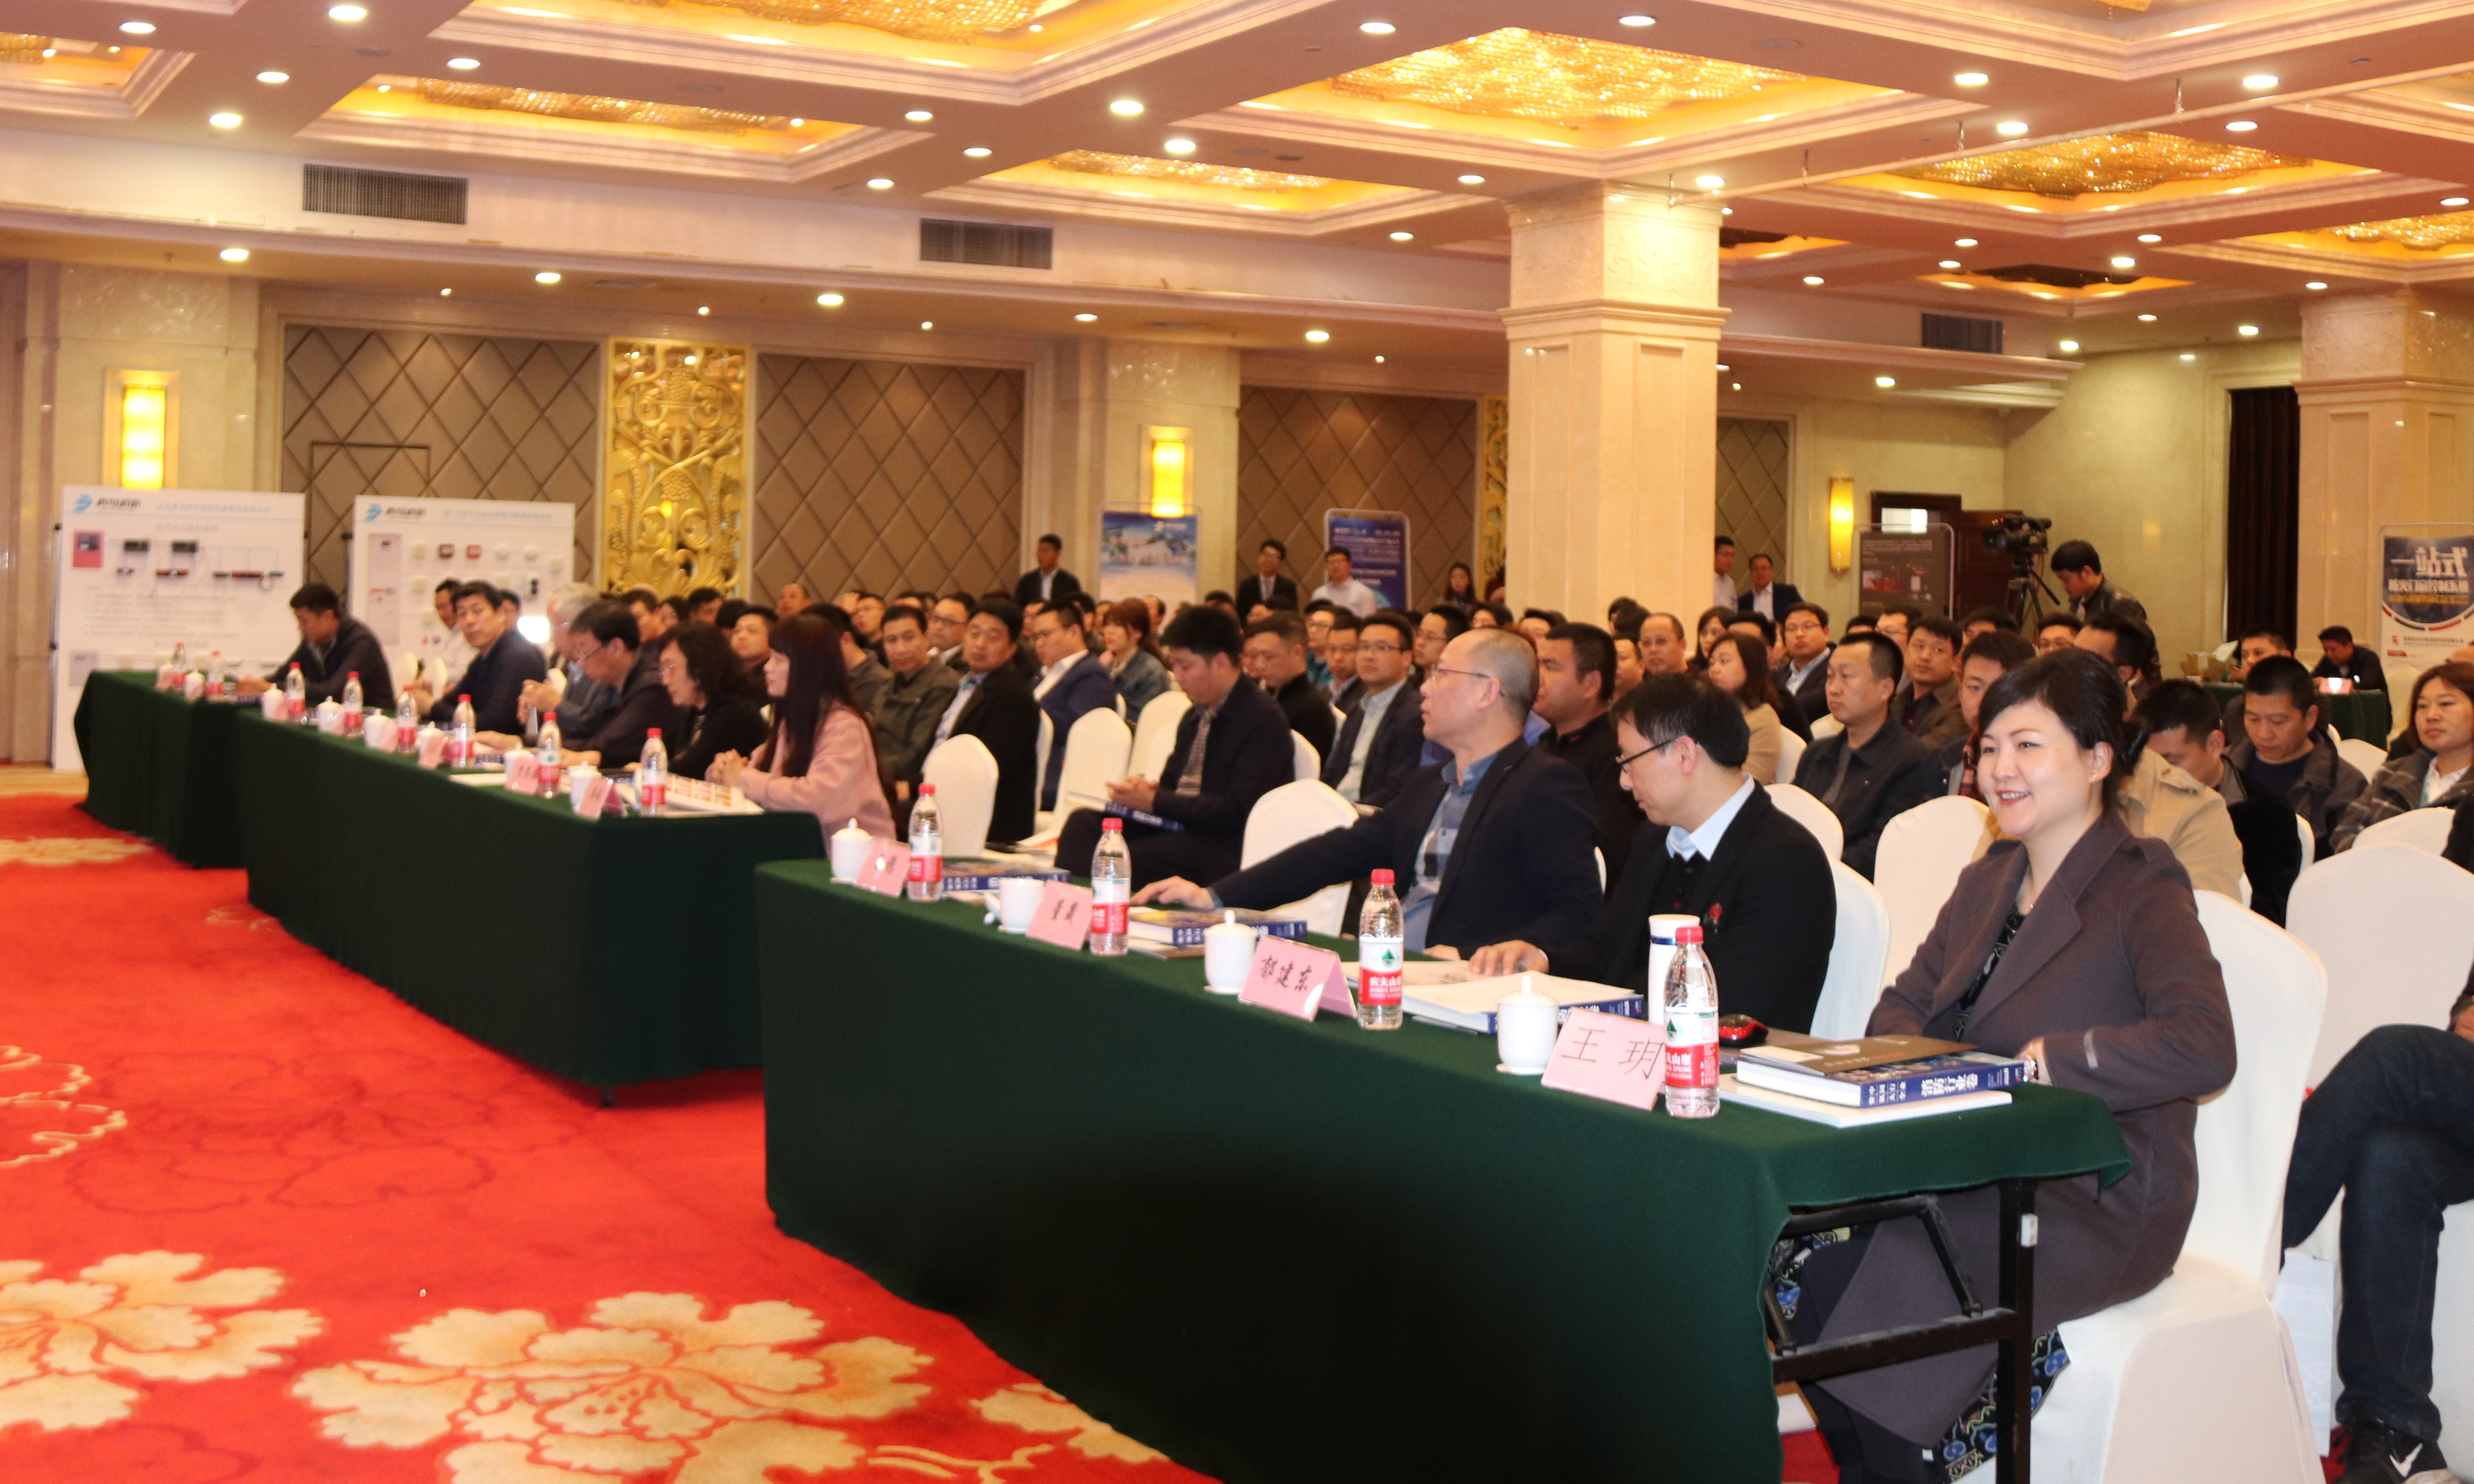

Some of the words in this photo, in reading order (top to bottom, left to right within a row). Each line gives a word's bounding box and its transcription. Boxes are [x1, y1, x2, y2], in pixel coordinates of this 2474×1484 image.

[1560, 1026, 1666, 1080] 王玥
[1920, 1072, 1979, 1097] 消防行业卷
